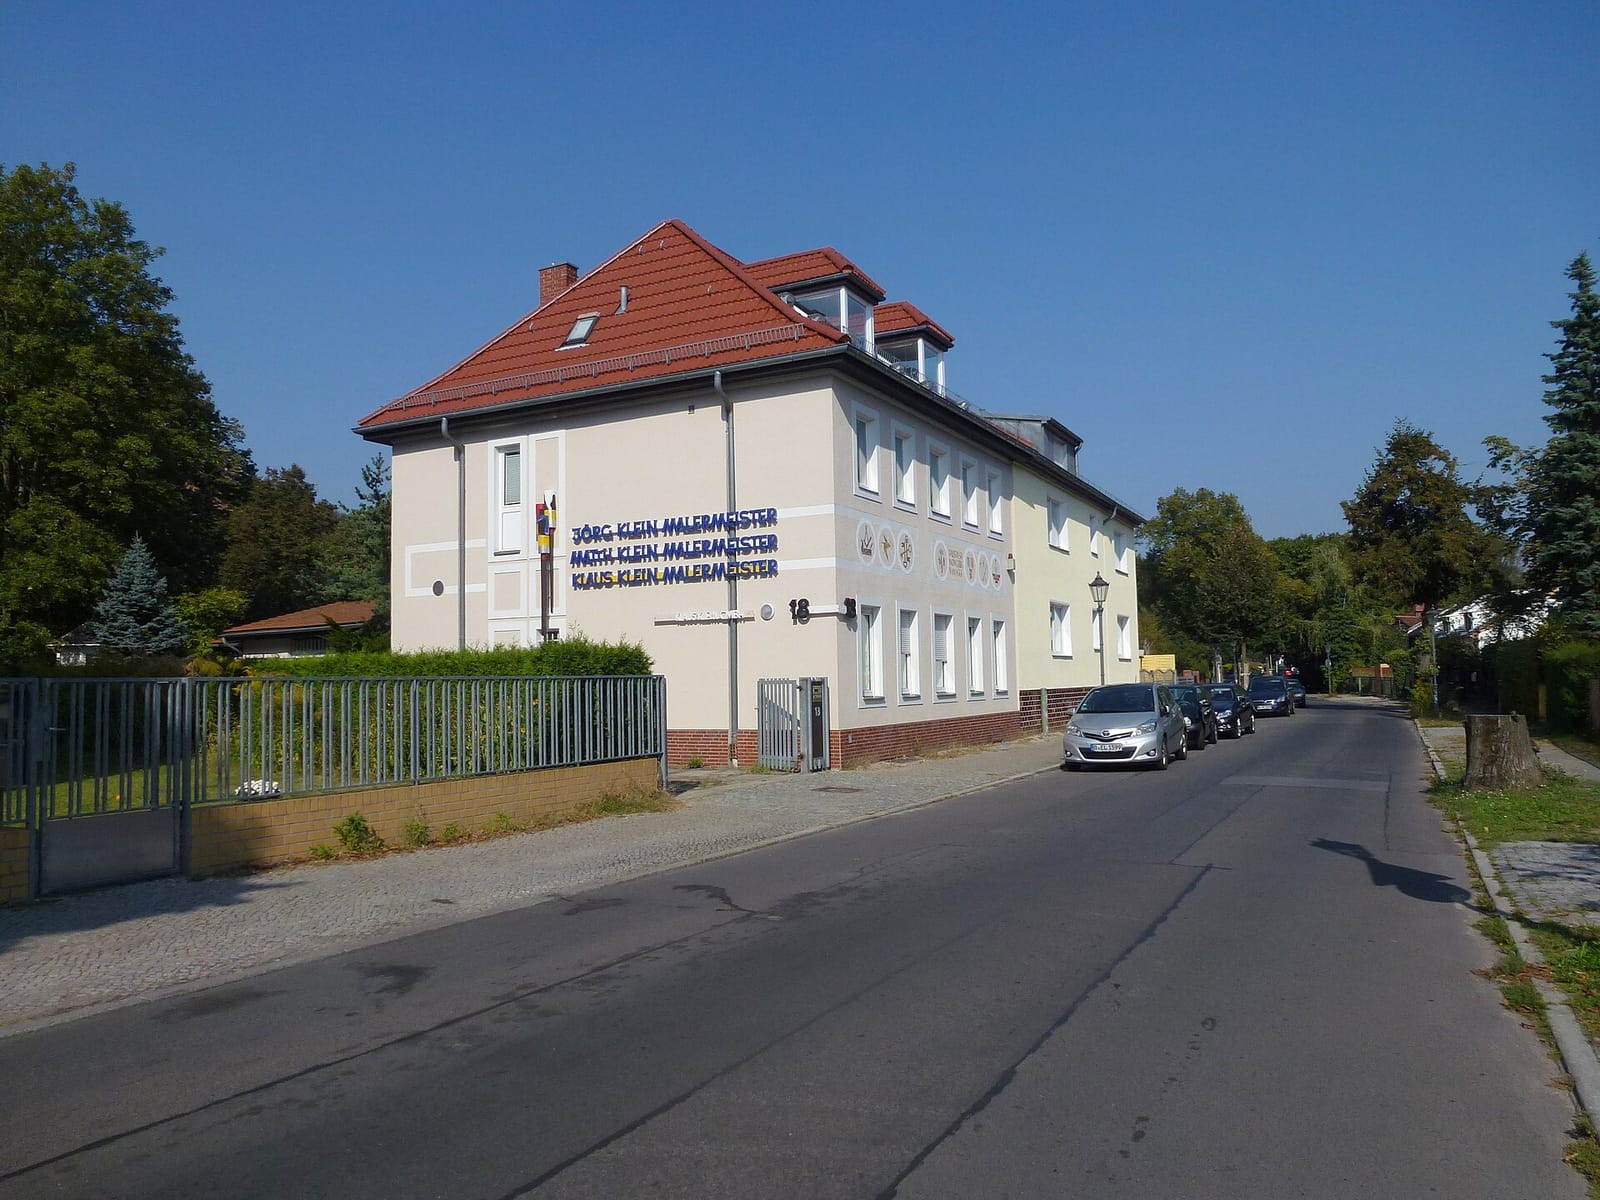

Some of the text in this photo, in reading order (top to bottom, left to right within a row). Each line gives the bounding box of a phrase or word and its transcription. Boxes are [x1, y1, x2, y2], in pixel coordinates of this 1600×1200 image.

[571, 508, 777, 543] JÖRG KLEIN MALERMEISTER
[617, 544, 658, 563] KLEIN
[663, 534, 778, 559] MALERMEISTER
[572, 559, 778, 589] KLAUS KLEIN MALERMEISTER
[789, 599, 810, 619] 18
